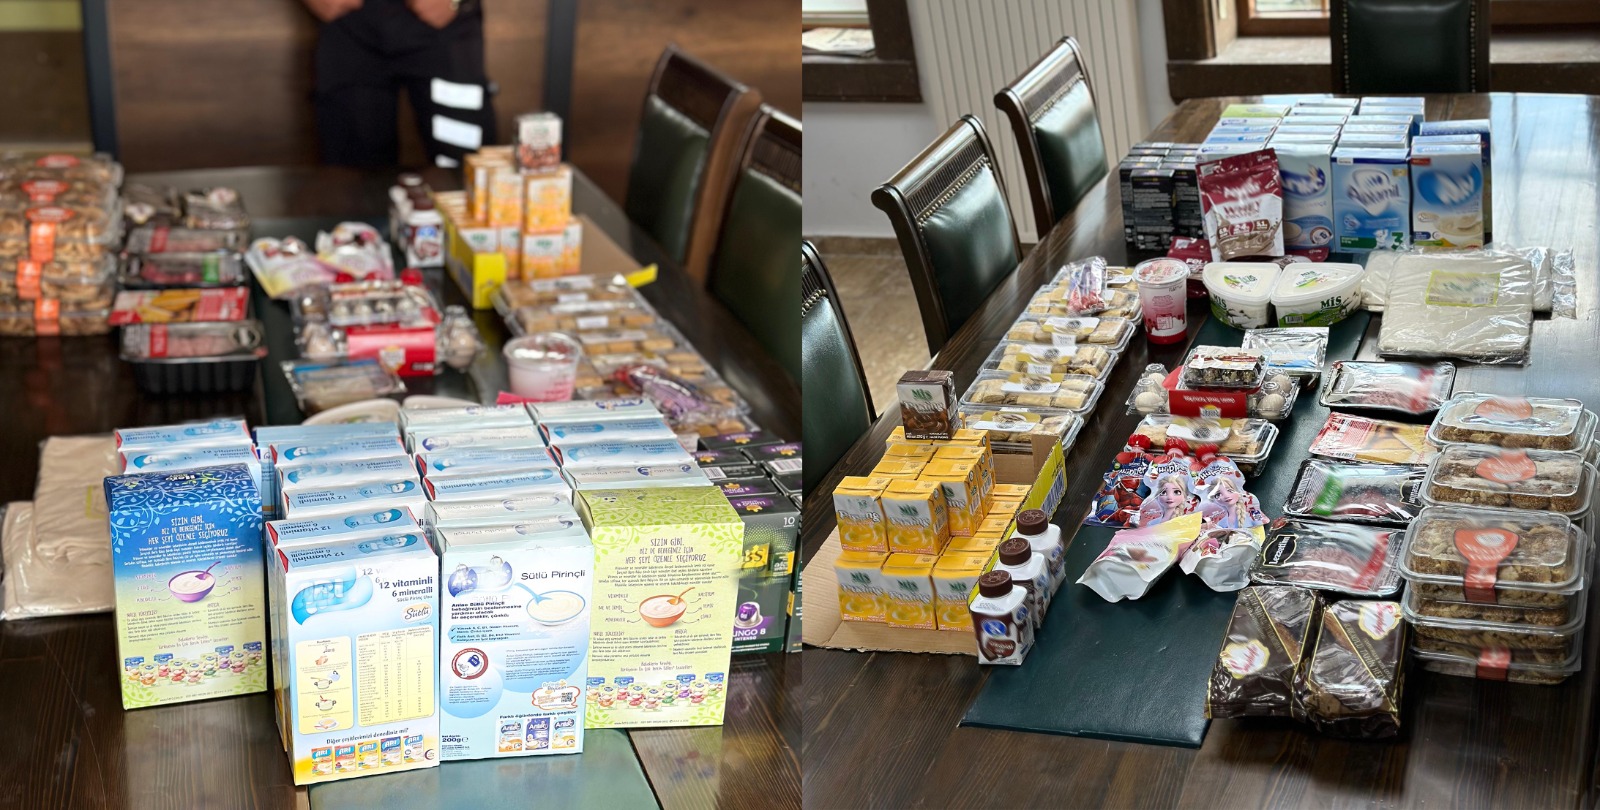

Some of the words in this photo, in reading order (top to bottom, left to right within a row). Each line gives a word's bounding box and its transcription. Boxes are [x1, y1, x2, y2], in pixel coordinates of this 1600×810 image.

[1391, 232, 1403, 249] 3
[1320, 295, 1342, 309] MİS
[171, 516, 188, 527] SİZİN
[783, 516, 796, 525] 10
[161, 527, 169, 535] BİZ
[204, 522, 215, 530] İÇİN
[148, 536, 159, 545] HER
[161, 534, 173, 545] ŞEYİ
[176, 532, 196, 542] ÖZENLE
[198, 528, 229, 539] SEÇİYORUZ
[650, 537, 668, 546] SİZİN
[640, 547, 648, 555] BİZ
[683, 546, 694, 554] İÇİN
[625, 556, 636, 564] HER
[638, 555, 651, 565] ŞEYİ
[653, 554, 673, 563] ÖZENLE
[676, 553, 707, 563] SEÇİYORUZ
[521, 570, 548, 581] Sütlü
[551, 569, 586, 580] Pirinçli
[379, 581, 390, 590] 12
[392, 576, 433, 588] vitaminli
[392, 590, 398, 598] 6
[399, 586, 433, 597] mineralli
[404, 606, 429, 620] Sütlü
[733, 629, 758, 637] UNGO
